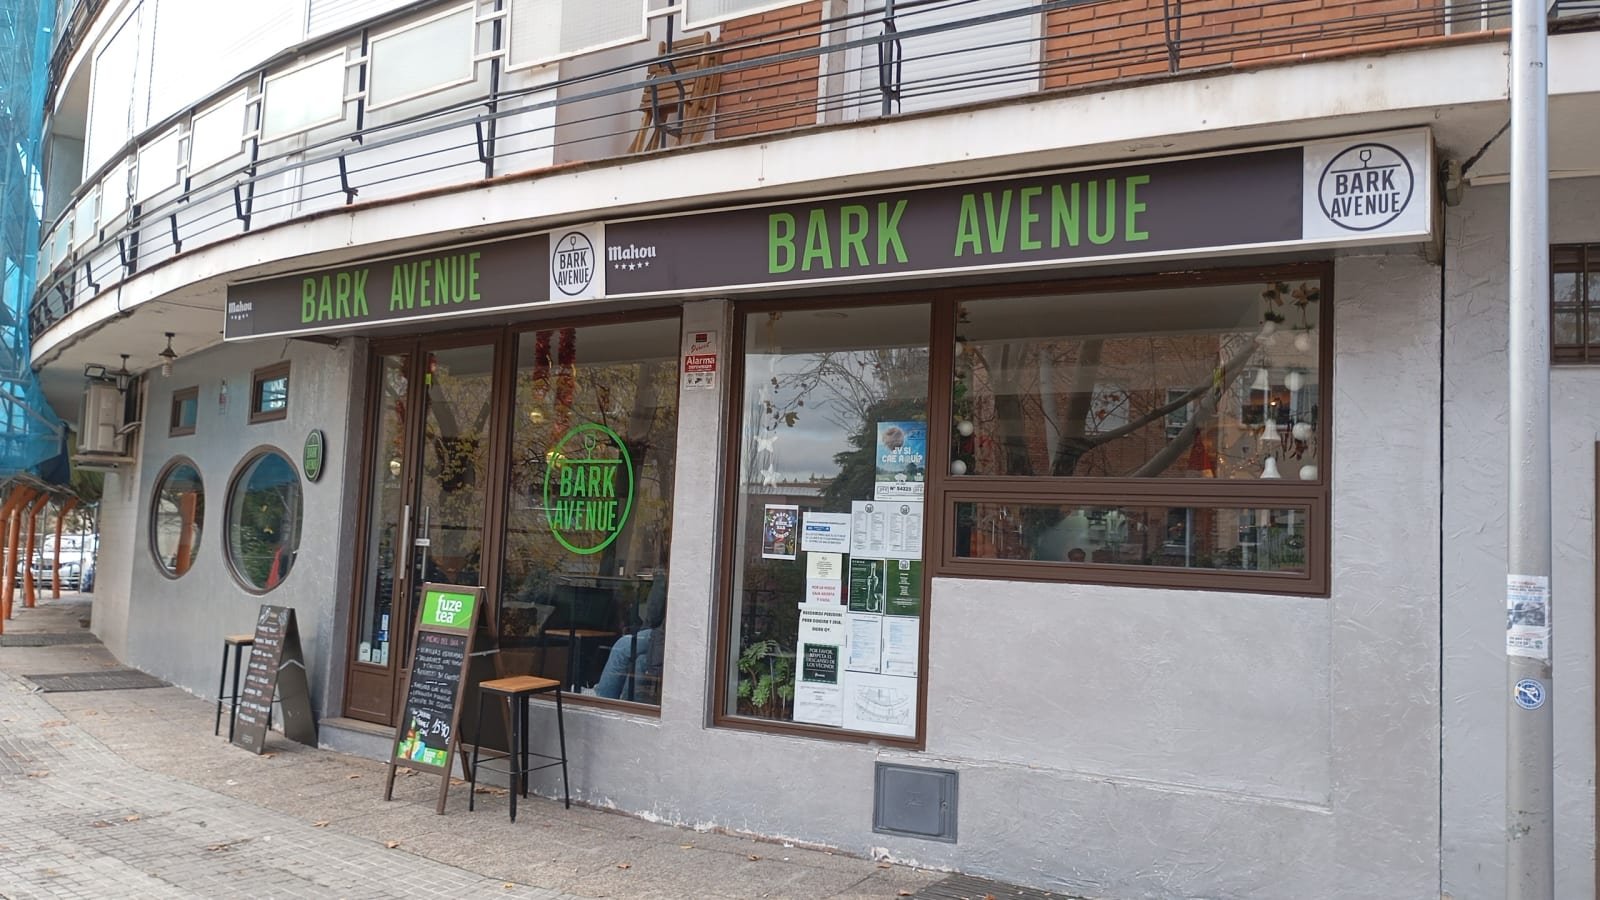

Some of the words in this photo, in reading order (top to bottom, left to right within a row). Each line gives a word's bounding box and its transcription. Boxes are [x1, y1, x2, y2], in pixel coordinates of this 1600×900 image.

[1336, 169, 1396, 196] BARK
[1330, 190, 1401, 219] AVENUE
[768, 198, 909, 275] BARK
[953, 174, 1151, 258] AVENUE
[559, 249, 587, 269] BARK
[607, 243, 657, 262] Mahou
[557, 267, 590, 287] AVENUE
[301, 268, 369, 324] BARK
[389, 252, 482, 311] AVENUE
[228, 300, 252, 313] Mahou
[686, 356, 715, 365] Alarma
[559, 465, 617, 497] BARK
[553, 500, 618, 531] AVENUE
[437, 594, 463, 613] fuze
[435, 610, 455, 624] tea
